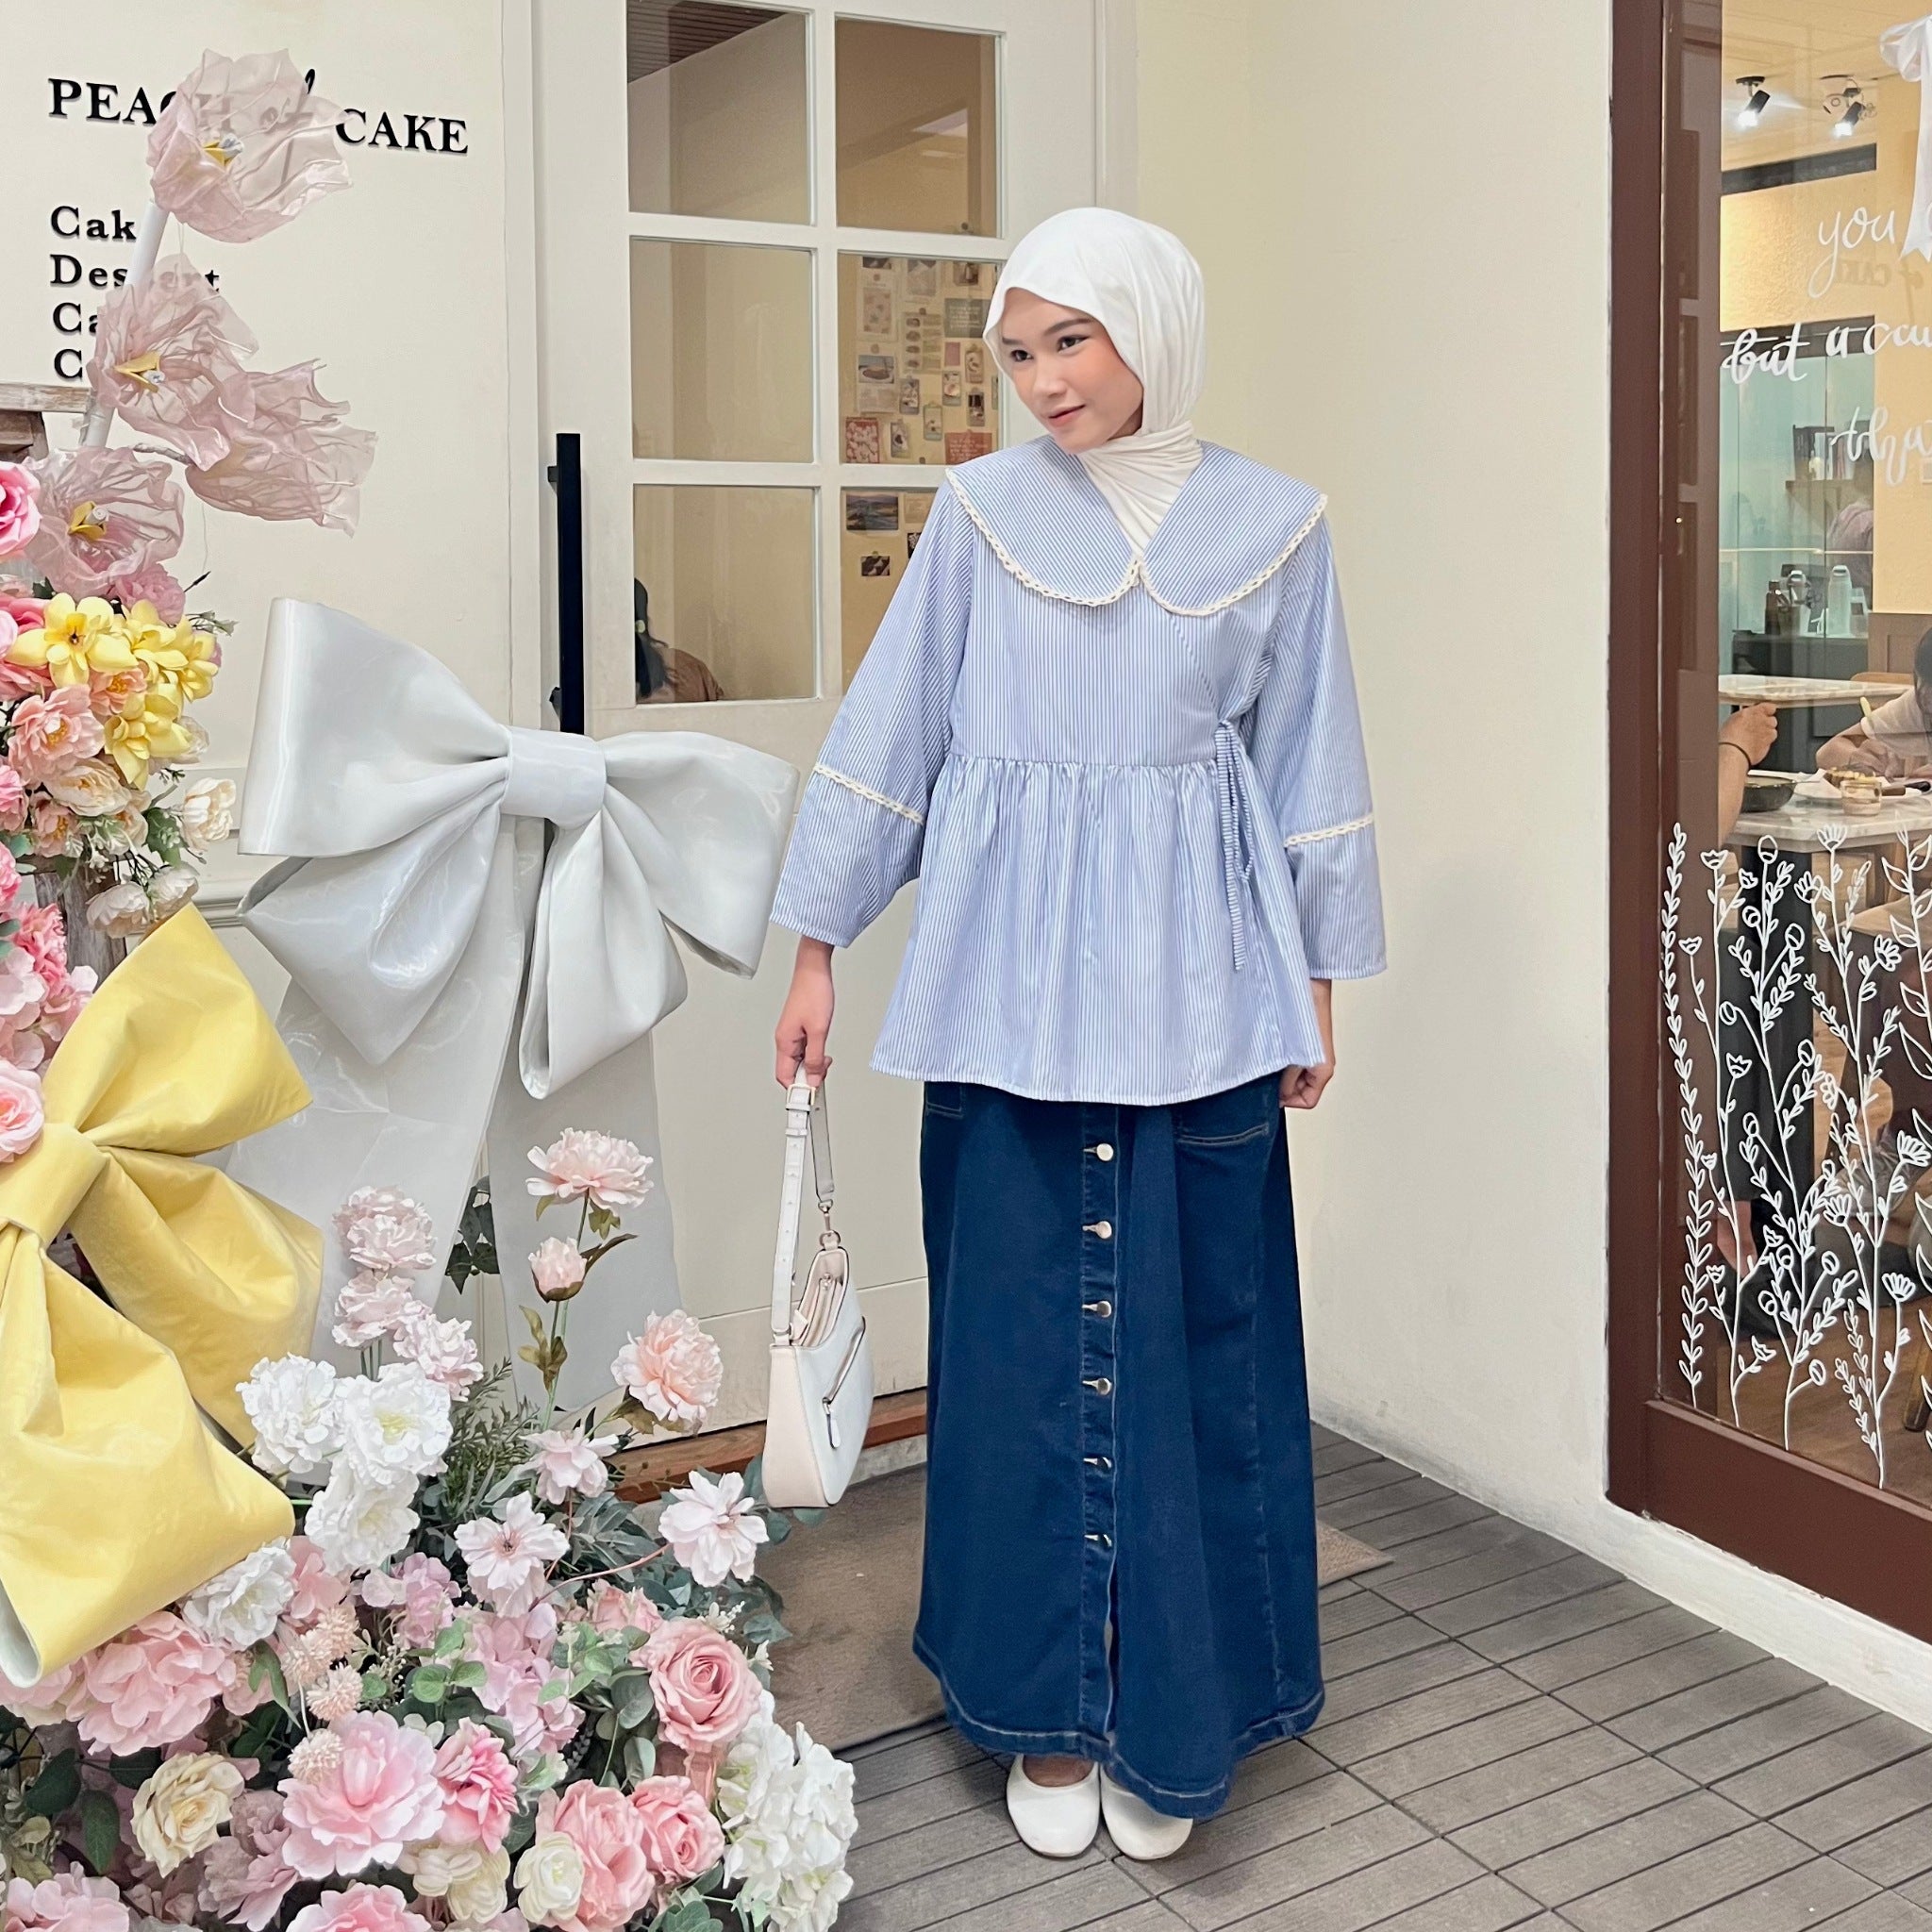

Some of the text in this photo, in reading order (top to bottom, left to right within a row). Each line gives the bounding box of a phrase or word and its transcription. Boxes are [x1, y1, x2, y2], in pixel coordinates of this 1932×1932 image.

[335, 108, 468, 154] CAKE
[51, 205, 138, 240] Cak
[1807, 207, 1895, 298] you
[1722, 322, 1810, 384] but
